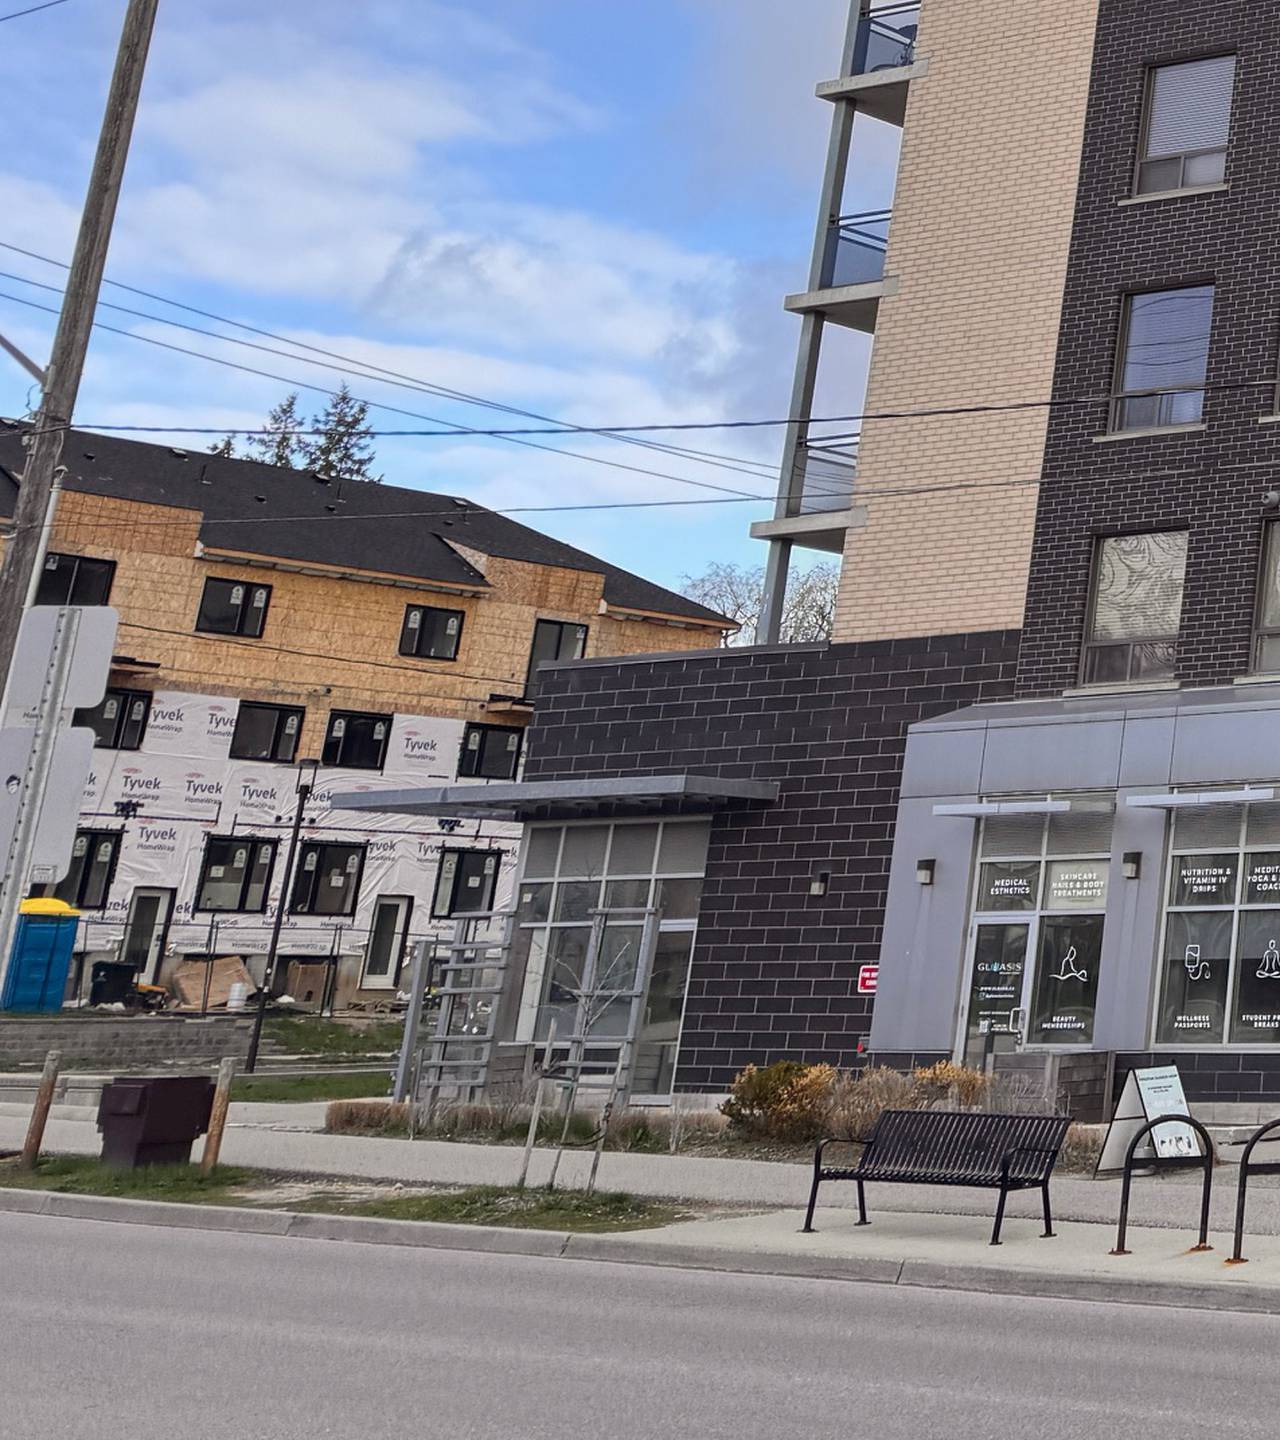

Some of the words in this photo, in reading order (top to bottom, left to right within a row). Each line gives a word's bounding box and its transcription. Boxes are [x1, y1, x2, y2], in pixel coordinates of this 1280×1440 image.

[151, 707, 184, 722] yvek
[208, 713, 236, 728] Tyve
[405, 737, 437, 752] Tyvek
[123, 776, 161, 791] Tyvek
[186, 780, 223, 795] Tyvek
[242, 785, 277, 800] Tyvek
[306, 791, 333, 803] yvek
[139, 826, 177, 841] Tyvek
[1181, 868, 1224, 876] NUTRITION
[1060, 873, 1097, 881] SKINCARE
[1183, 877, 1217, 885] VITAMIN
[1219, 876, 1228, 884] IV
[994, 879, 1028, 887] MEDICAL
[990, 887, 1031, 895] ESTHETICS
[1053, 889, 1102, 897] TREATMENTS
[1192, 885, 1217, 893] DRIPS
